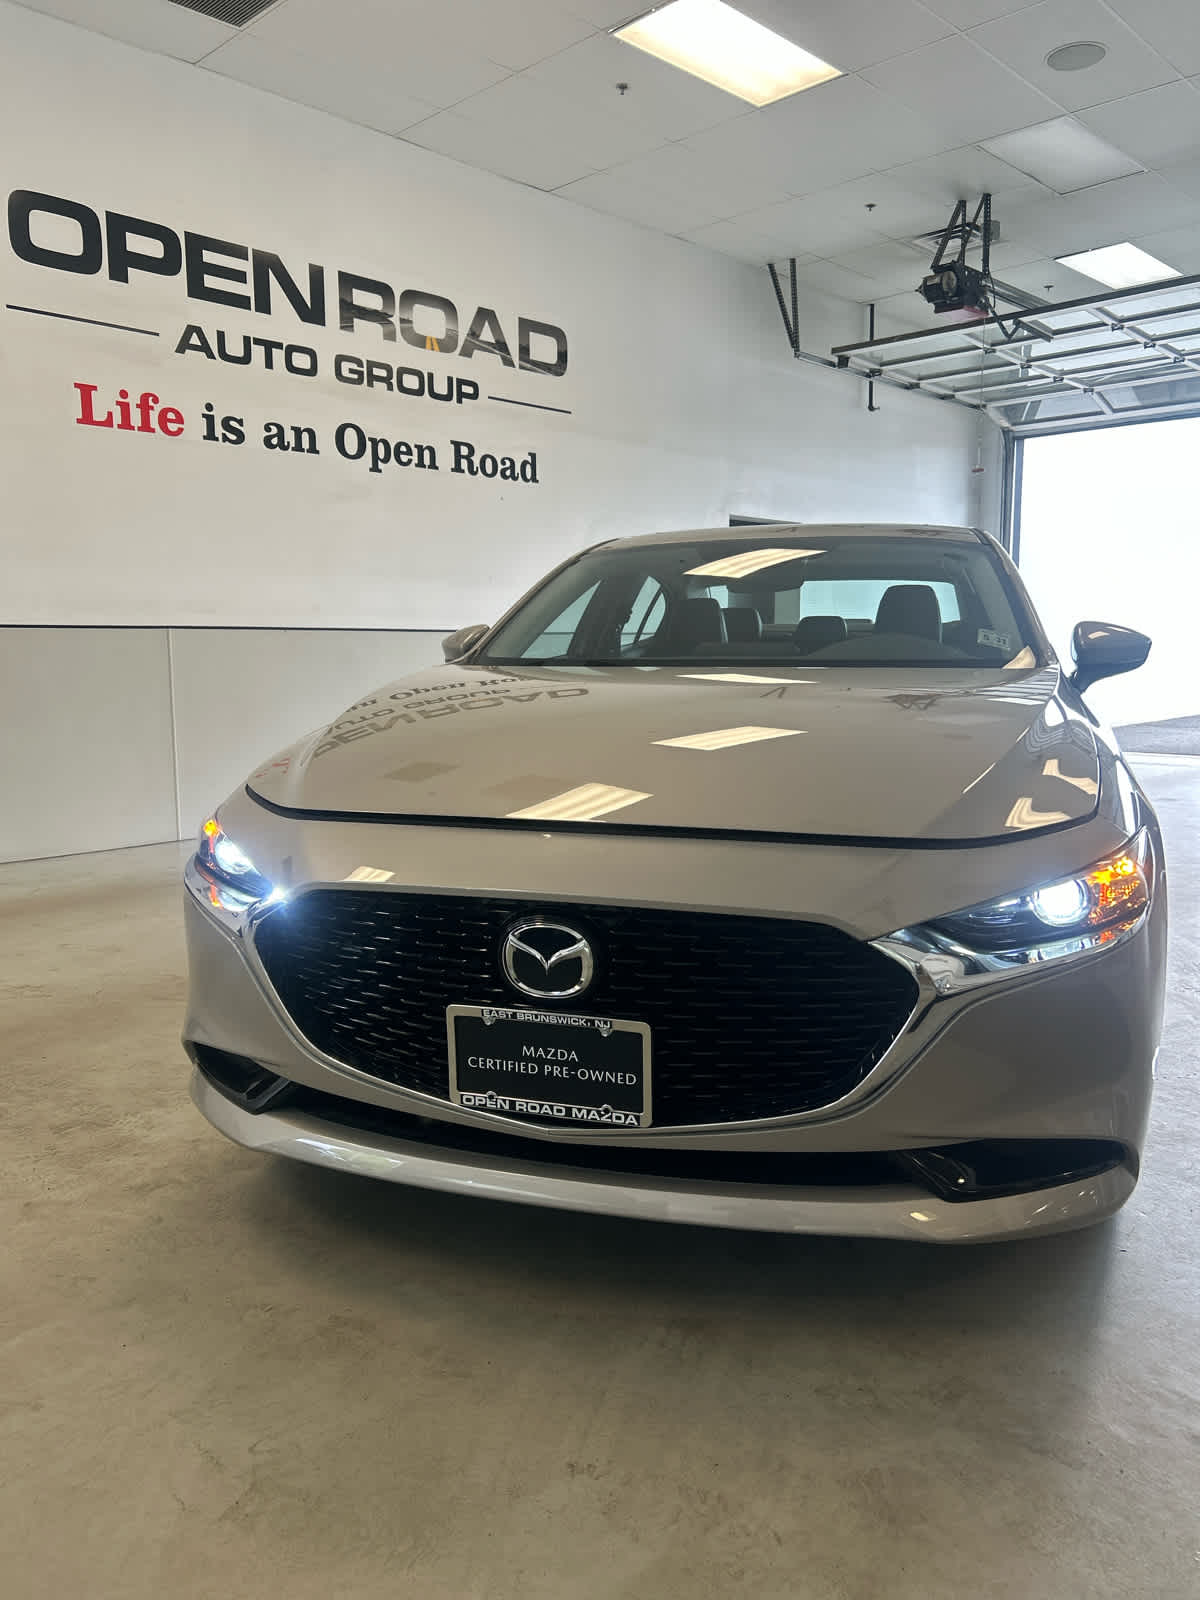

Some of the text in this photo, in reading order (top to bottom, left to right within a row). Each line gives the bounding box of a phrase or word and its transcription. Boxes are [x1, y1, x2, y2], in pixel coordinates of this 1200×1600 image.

[174, 324, 480, 404] AUTO GROUP
[73, 382, 539, 483] Life is an Open Road
[482, 1009, 611, 1028] EAST BRUNSWICK, NJ
[522, 1045, 579, 1062] MAZDA
[467, 1056, 638, 1085] CERTIFIED PRE-OWNED
[462, 1095, 639, 1126] OPEN ROAD MAZDA
